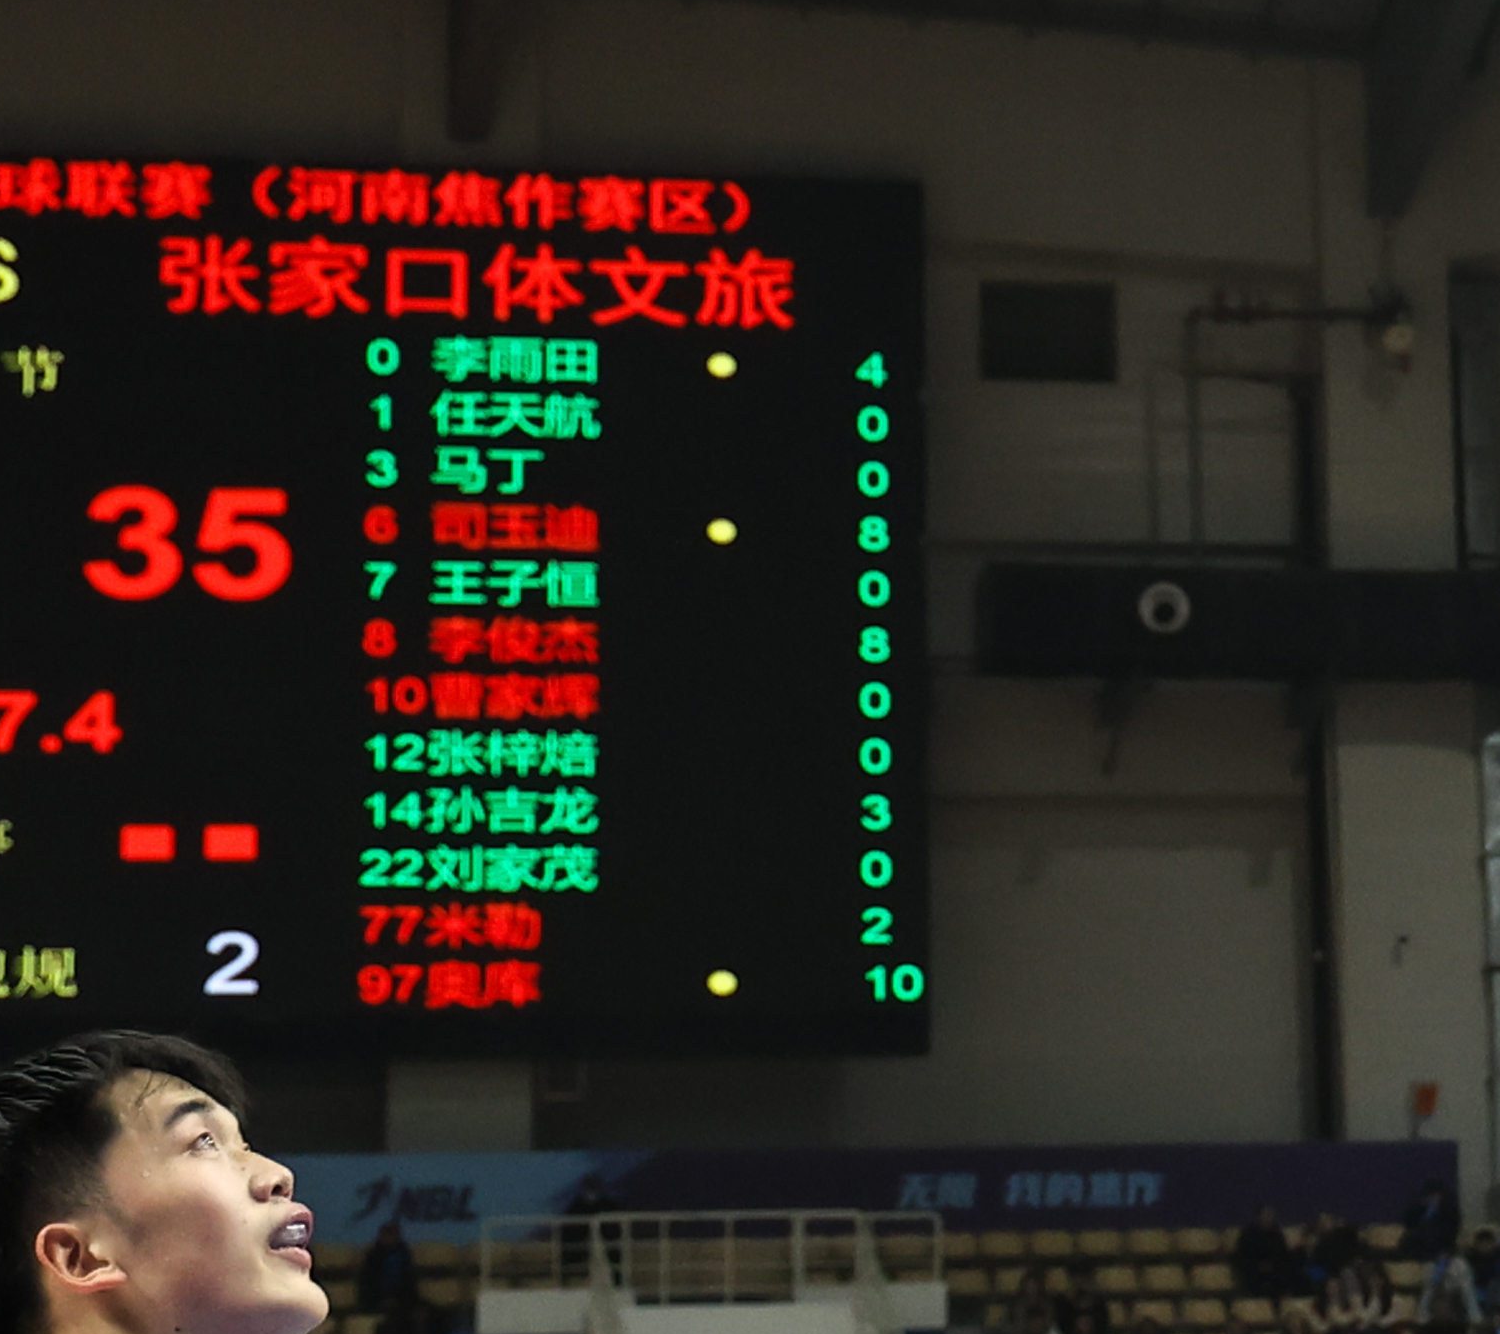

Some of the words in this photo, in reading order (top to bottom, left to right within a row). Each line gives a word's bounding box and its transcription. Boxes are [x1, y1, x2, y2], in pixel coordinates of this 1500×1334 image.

[159, 234, 794, 329] 张家口体文旅
[366, 338, 399, 375] 0
[433, 336, 598, 383] 李雨田
[856, 353, 887, 387] 4
[370, 395, 391, 430] 1
[430, 390, 601, 439] 任天航
[857, 406, 889, 442] 0
[366, 450, 398, 487] 3
[431, 446, 544, 494] 马丁
[858, 461, 889, 497] 0
[83, 485, 292, 601] 35
[363, 506, 398, 544] 6
[858, 516, 890, 552] 8
[365, 562, 396, 598] 7
[429, 561, 598, 607] 王子恒
[858, 571, 890, 607] 0
[362, 618, 397, 658] 8
[859, 626, 890, 663] 8
[859, 682, 891, 718] 0
[860, 738, 891, 774] 0
[861, 794, 891, 831] 3
[860, 851, 893, 887] 0
[861, 907, 892, 944] 2
[204, 931, 258, 994] 2
[865, 965, 923, 1001] 10
